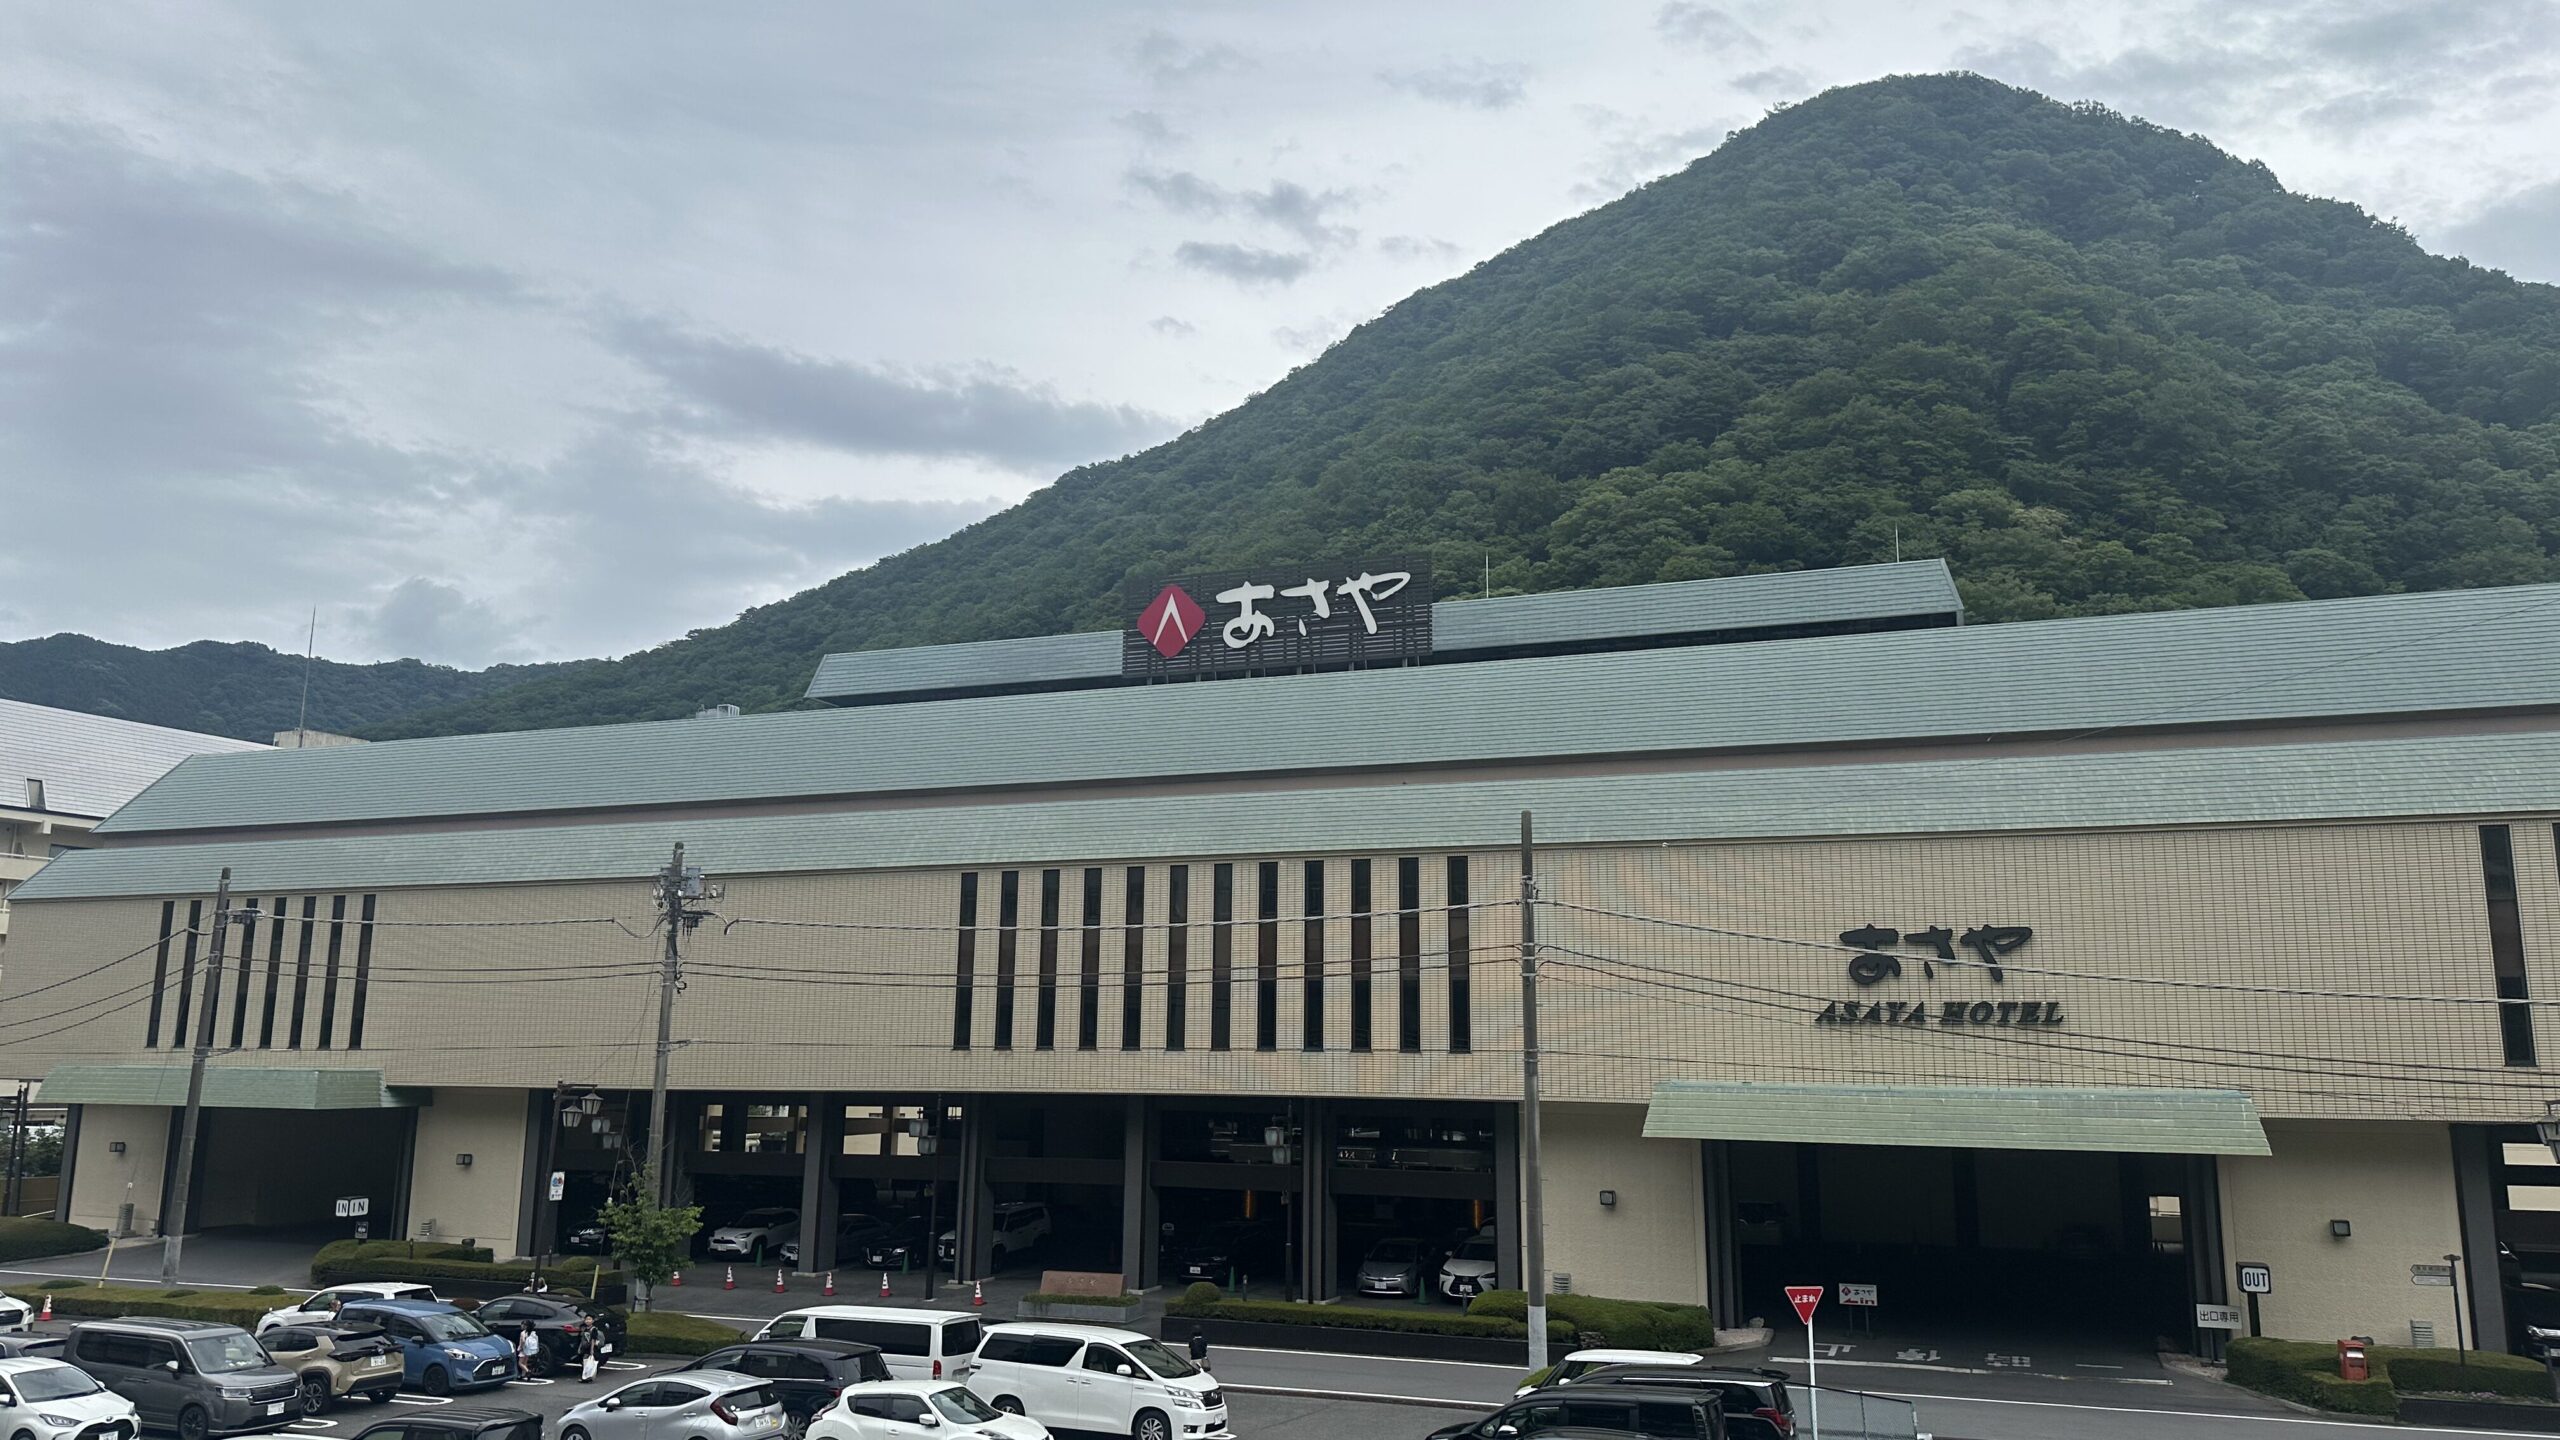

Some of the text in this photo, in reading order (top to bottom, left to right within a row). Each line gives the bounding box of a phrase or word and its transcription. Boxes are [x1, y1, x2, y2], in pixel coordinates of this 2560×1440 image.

[1215, 571, 1411, 649] あさや
[1839, 923, 2033, 985] あさや
[1815, 1000, 2065, 1025] ASAYA HOTEL
[338, 1202, 347, 1213] IN
[353, 1201, 365, 1213] IN
[2245, 1272, 2266, 1287] OUT
[1794, 1294, 1816, 1304] 止まれ
[2200, 1310, 2239, 1322] 出口専用
